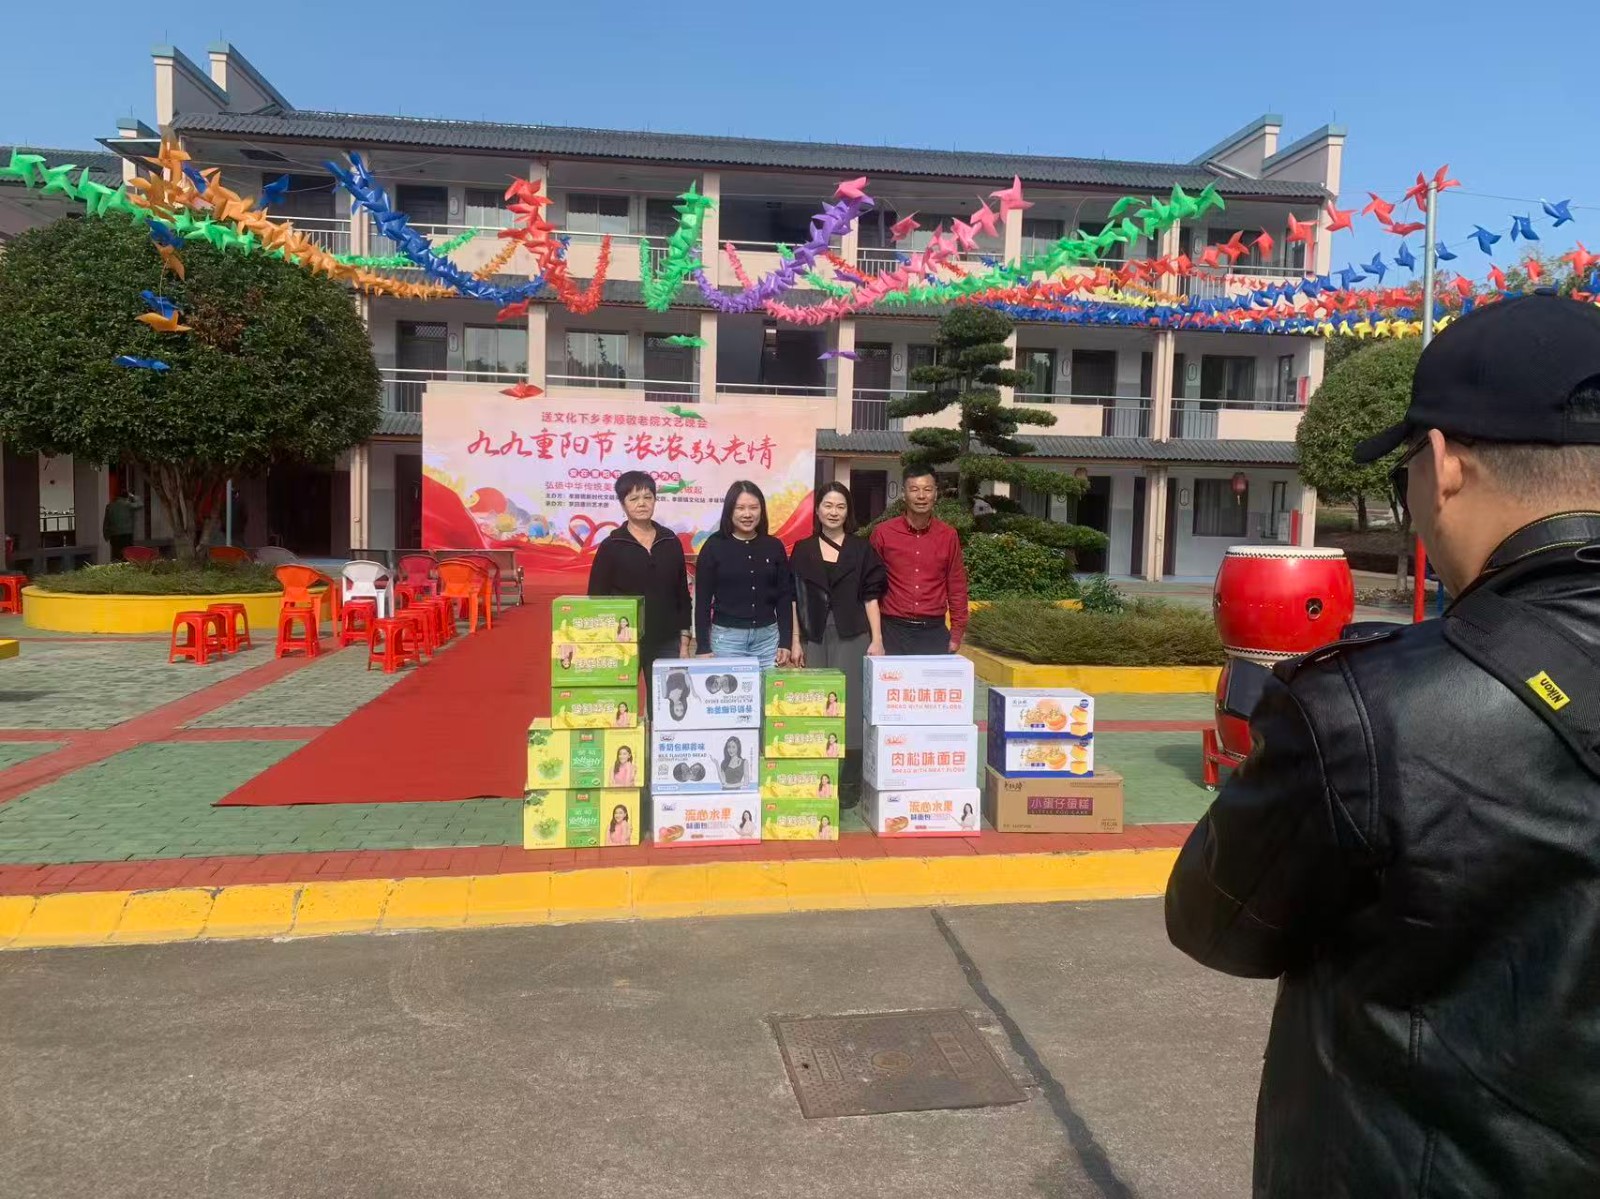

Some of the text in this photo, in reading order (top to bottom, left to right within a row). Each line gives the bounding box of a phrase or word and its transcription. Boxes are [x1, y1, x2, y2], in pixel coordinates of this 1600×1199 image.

[541, 411, 709, 428] 送文化下乡孝顺敬老院文艺晚会
[467, 430, 616, 463] 九九重阳节
[545, 481, 615, 491] 弘扬中华传统美
[886, 688, 963, 703] 肉松味面包
[1540, 678, 1564, 703] Nikon
[891, 752, 966, 766] 肉松味面包
[1031, 798, 1090, 809] 小蛋仔蛋糕
